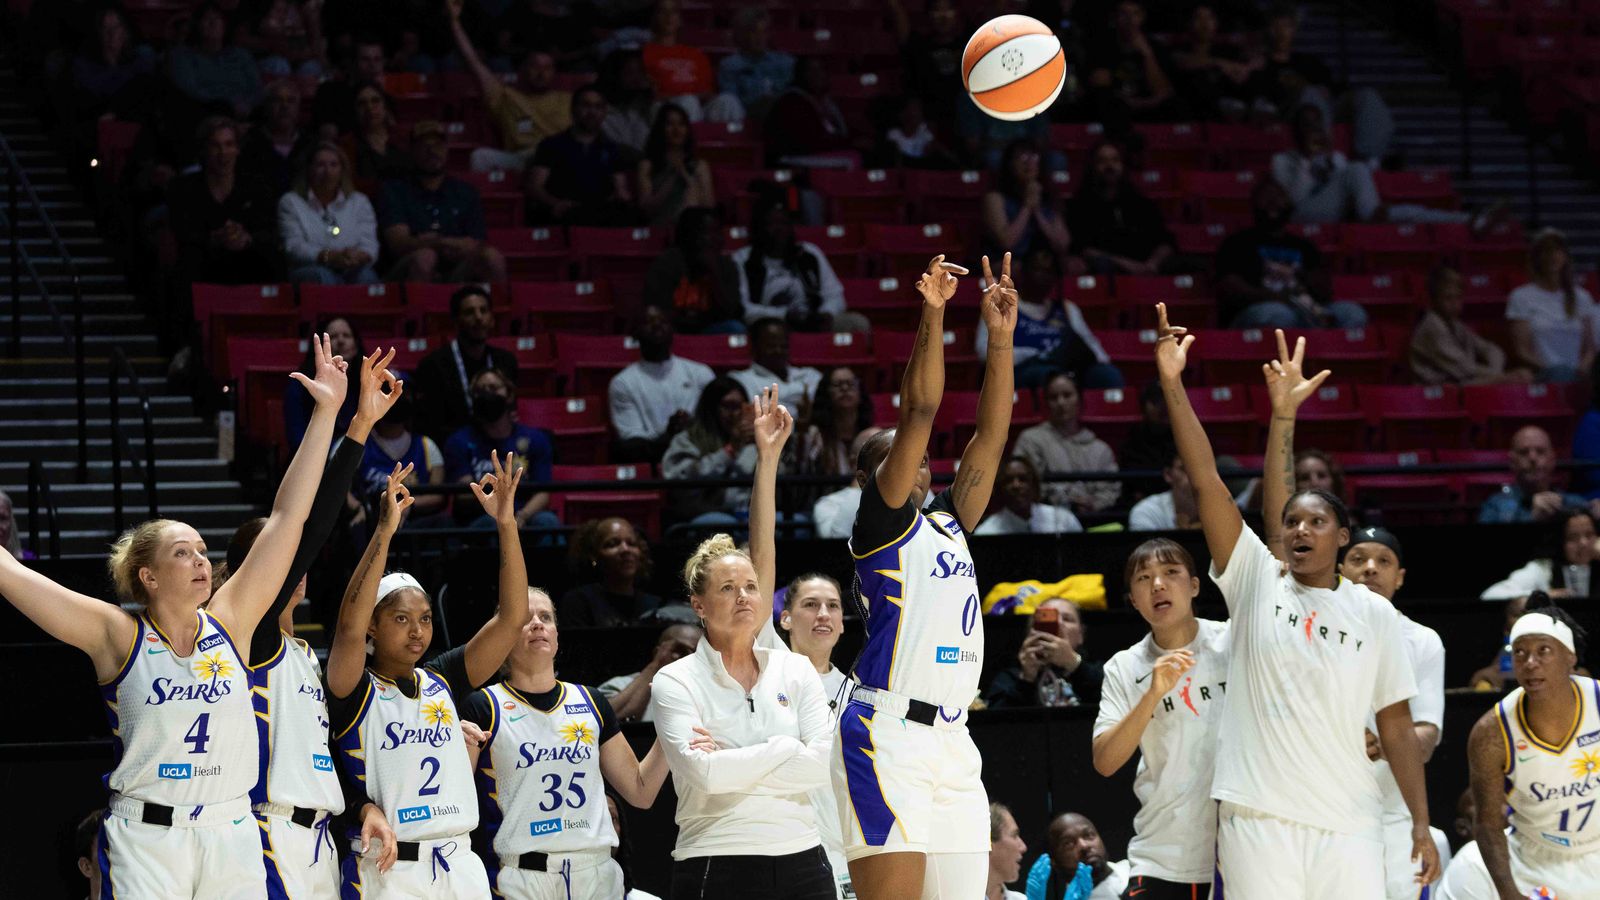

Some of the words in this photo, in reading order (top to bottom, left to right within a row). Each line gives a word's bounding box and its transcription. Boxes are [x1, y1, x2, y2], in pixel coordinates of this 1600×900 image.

[930, 551, 977, 579] SPA
[962, 593, 978, 637] 0
[200, 635, 224, 651] Albert
[567, 705, 589, 714] Albert
[184, 713, 210, 754] 4
[163, 767, 188, 777] UCLA
[418, 756, 440, 796] 2
[539, 772, 587, 812] 35
[402, 809, 427, 821] UCLA
[534, 823, 558, 833] UCLA
[1558, 799, 1596, 832] 17
